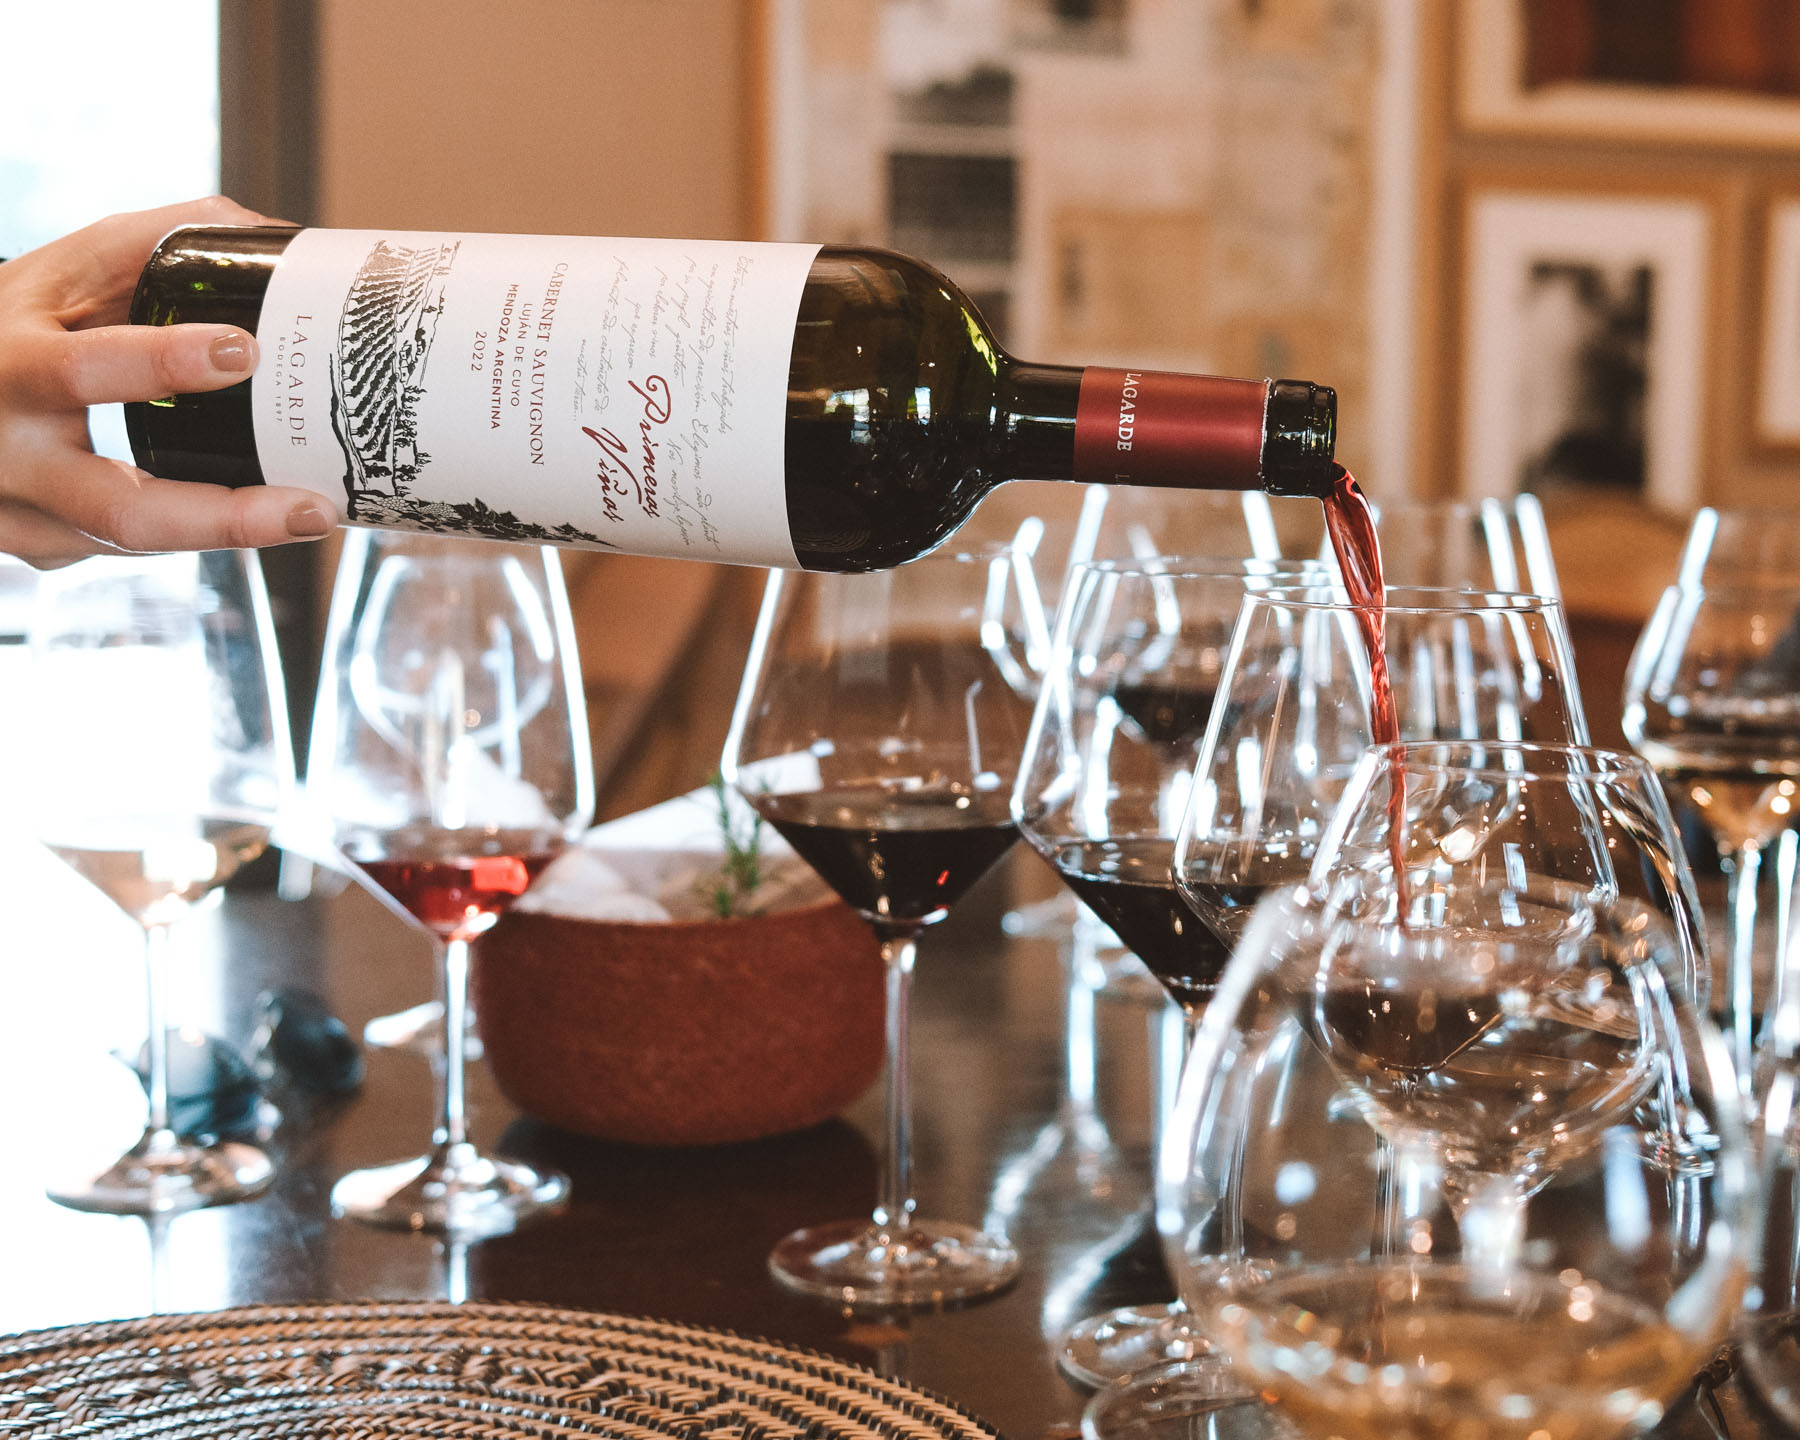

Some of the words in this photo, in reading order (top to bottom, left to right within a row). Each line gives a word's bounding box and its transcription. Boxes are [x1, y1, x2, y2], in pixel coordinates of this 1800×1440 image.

[497, 284, 520, 343] MENDOZA
[517, 303, 533, 339] LUJÁN
[536, 262, 569, 342] CABERNET
[602, 310, 617, 333] cada
[624, 297, 641, 319] que
[653, 290, 669, 324] elaborar
[671, 282, 691, 328] perfil
[698, 280, 717, 336] agricultura
[724, 295, 739, 347] nuestras
[275, 336, 286, 386] BODEGA
[471, 331, 488, 371] 2022
[514, 346, 525, 363] DE
[577, 339, 588, 378] nuestra
[621, 323, 637, 368] expresan
[649, 329, 659, 360] vinos
[699, 334, 715, 353] de
[289, 315, 312, 446] LAGARDE
[491, 350, 505, 429] ARGENTINA
[511, 370, 522, 407] CUYO
[711, 370, 735, 434] trabajadas
[530, 348, 548, 466] SAUVIGNON
[595, 395, 609, 415] de
[1117, 373, 1142, 451] LAGARDE
[628, 375, 671, 518] Primeras
[667, 438, 683, 465] Nos
[681, 419, 709, 480] Elegimos
[582, 427, 642, 523] Viñas
[696, 487, 712, 510] cada
[688, 504, 721, 552] planta
